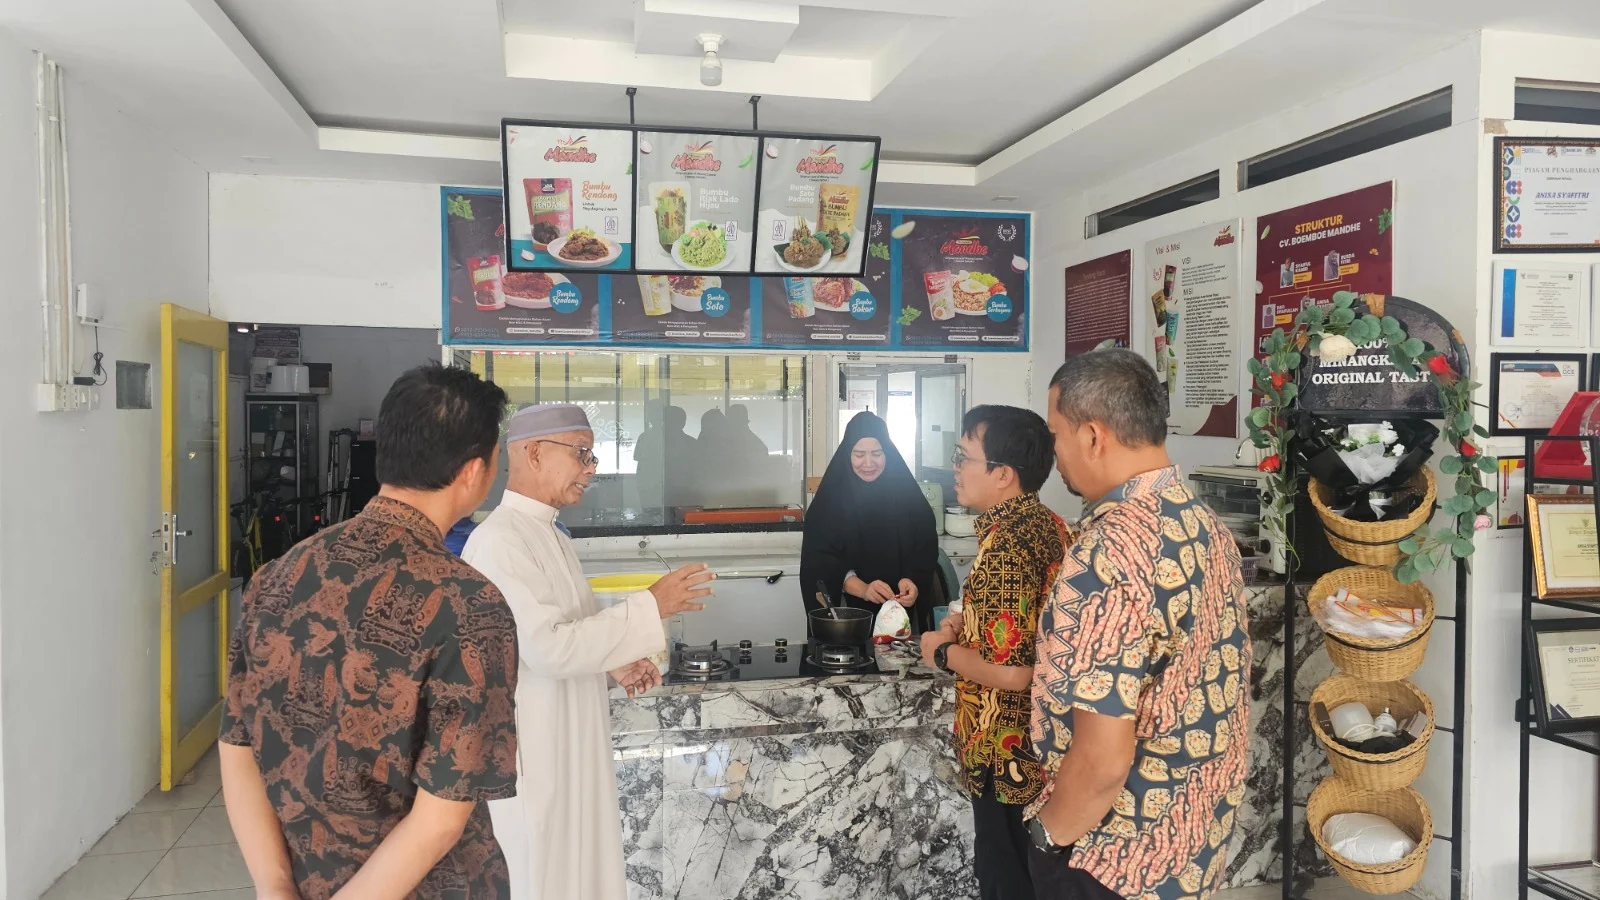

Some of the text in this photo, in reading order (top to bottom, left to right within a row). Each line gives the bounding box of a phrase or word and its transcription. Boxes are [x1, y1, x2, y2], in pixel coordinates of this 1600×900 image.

[582, 181, 611, 190] Bumbu
[582, 190, 618, 201] Rendang
[700, 188, 728, 196] Bumbu
[1295, 215, 1343, 234] STRUKTUR
[1279, 222, 1361, 248] CV. BOEMBOE MANDHE
[940, 240, 988, 256] Mandhe
[1156, 246, 1164, 254] Visi
[1170, 242, 1180, 252] Misi
[706, 301, 724, 310] Soto
[1312, 370, 1432, 384] ORIGINAL TAST
